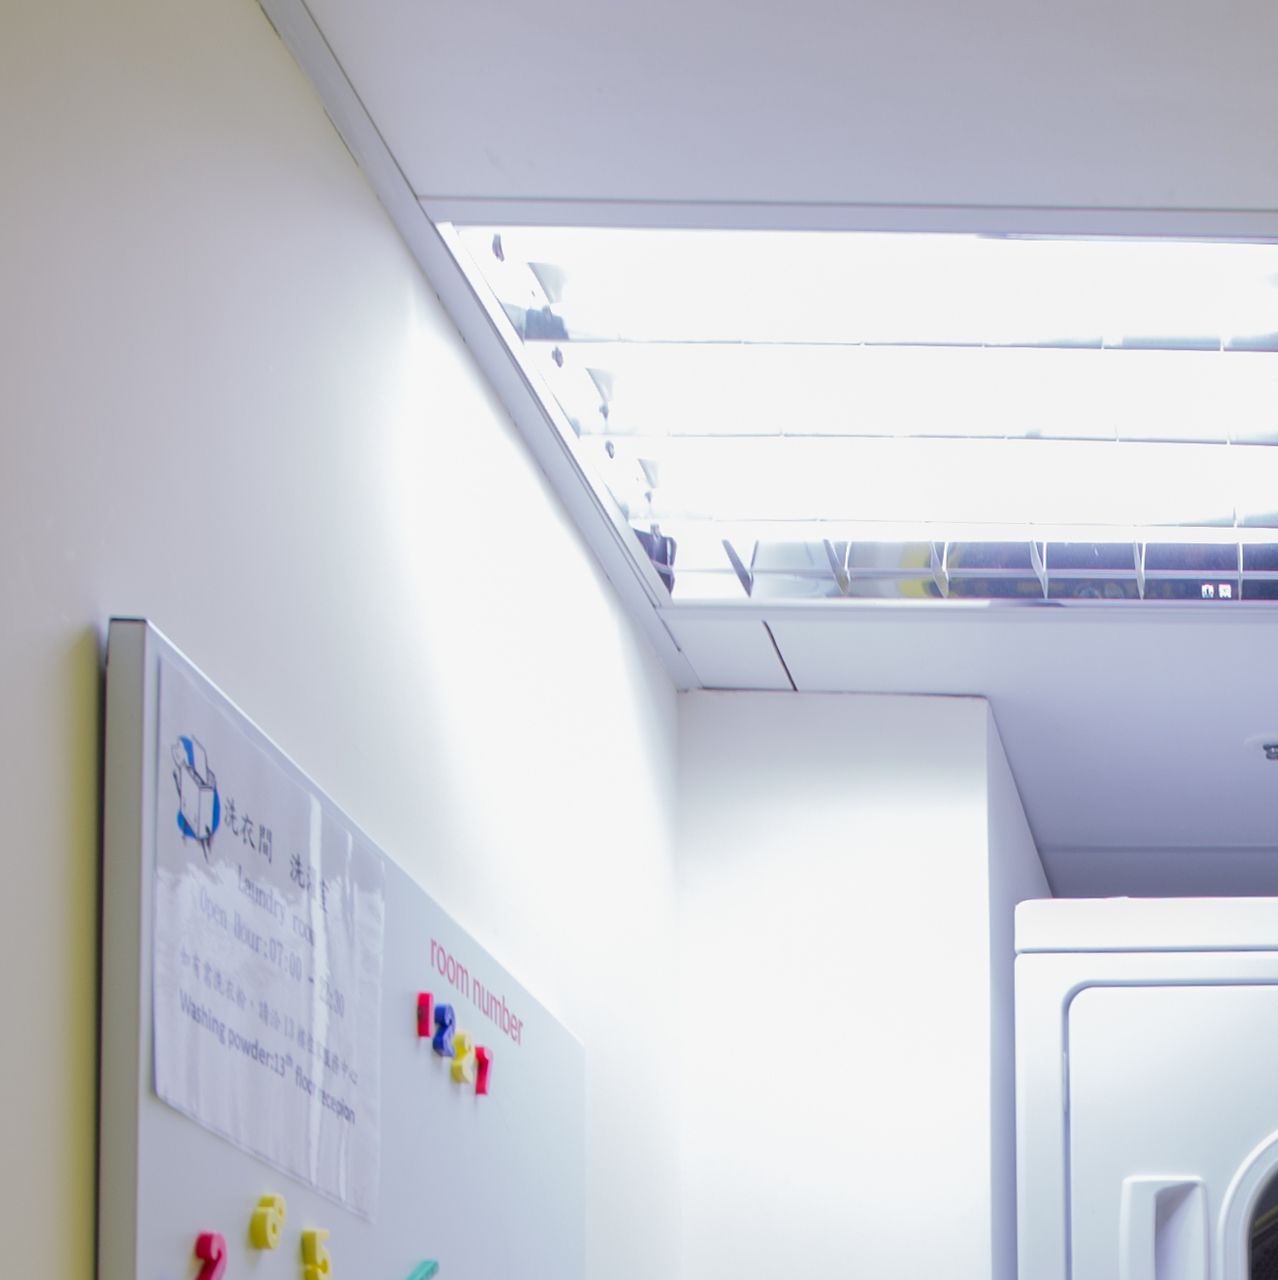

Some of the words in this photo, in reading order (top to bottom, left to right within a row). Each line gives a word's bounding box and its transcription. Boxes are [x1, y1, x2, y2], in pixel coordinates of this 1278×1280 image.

[225, 796, 273, 864] 洗衣間
[238, 864, 286, 926] Laundry
[179, 987, 226, 1046] Washing
[431, 937, 470, 998] room
[473, 977, 524, 1046] number
